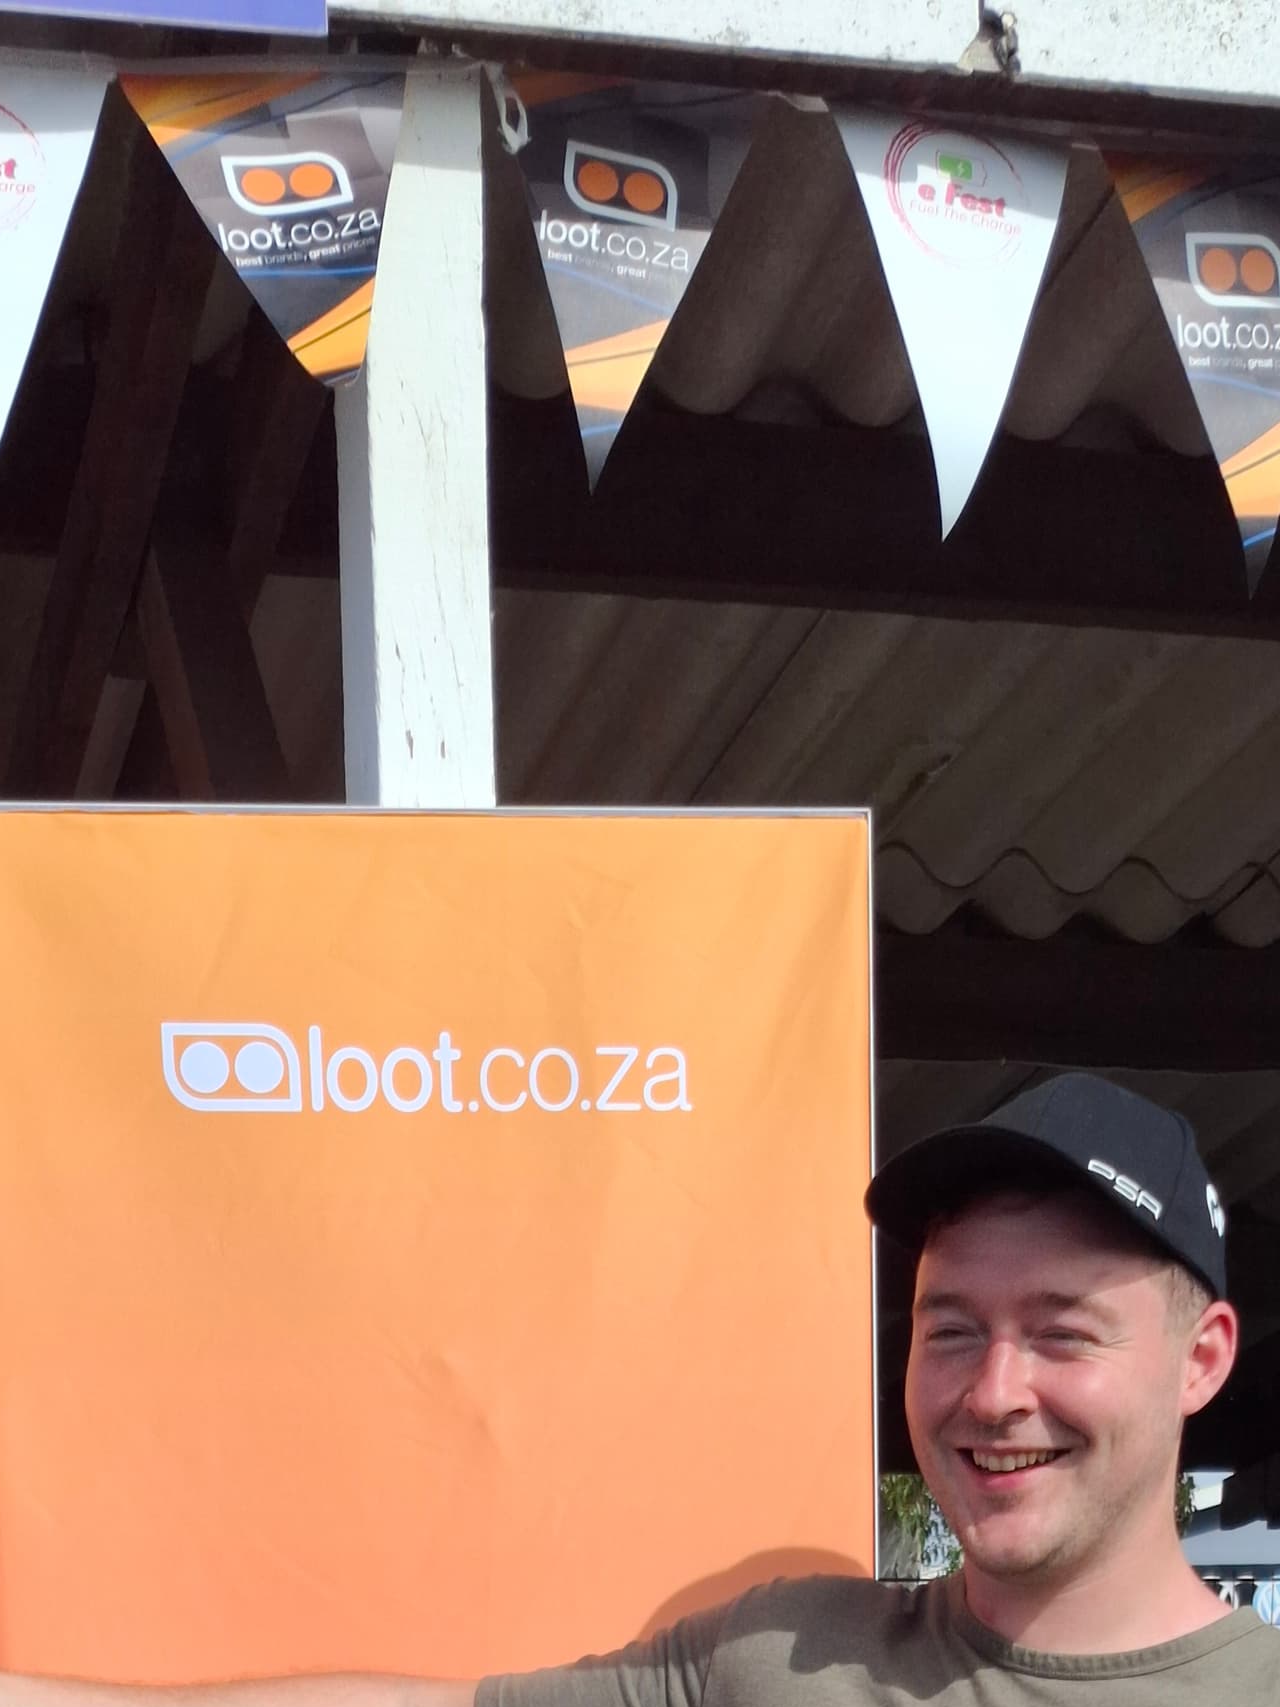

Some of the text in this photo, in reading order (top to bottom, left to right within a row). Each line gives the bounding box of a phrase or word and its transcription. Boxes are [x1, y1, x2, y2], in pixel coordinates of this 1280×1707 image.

[217, 208, 381, 252] loot.co.za
[539, 208, 690, 272] loot.co.za
[309, 1025, 692, 1112] loot.co.za
